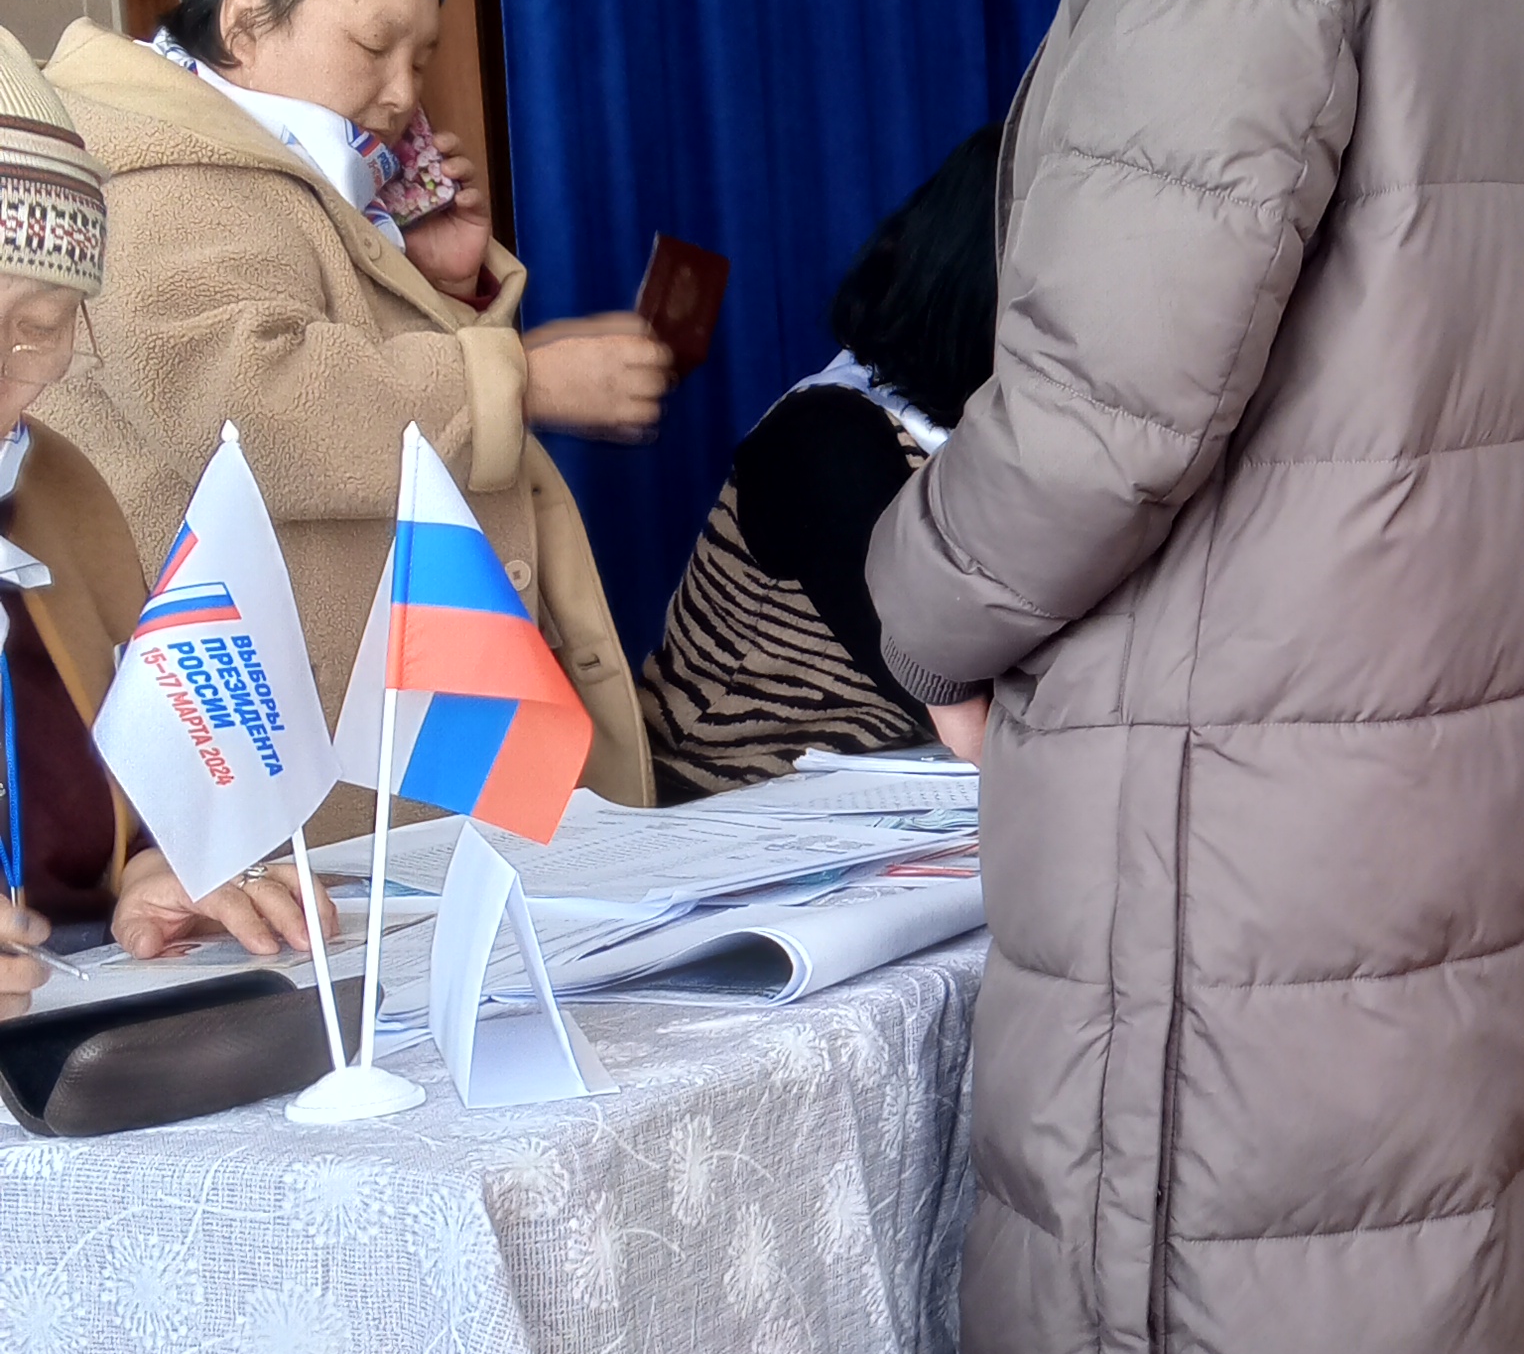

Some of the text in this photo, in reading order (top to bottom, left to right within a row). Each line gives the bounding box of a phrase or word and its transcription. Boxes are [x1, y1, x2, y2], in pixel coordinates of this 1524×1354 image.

[167, 641, 236, 729] РОССИИ
[200, 637, 284, 777] ПРЕЗИДЕНТА
[230, 635, 285, 731] ВЫБОРЫ
[166, 691, 213, 746] МАРТА
[198, 747, 235, 785] 2024
